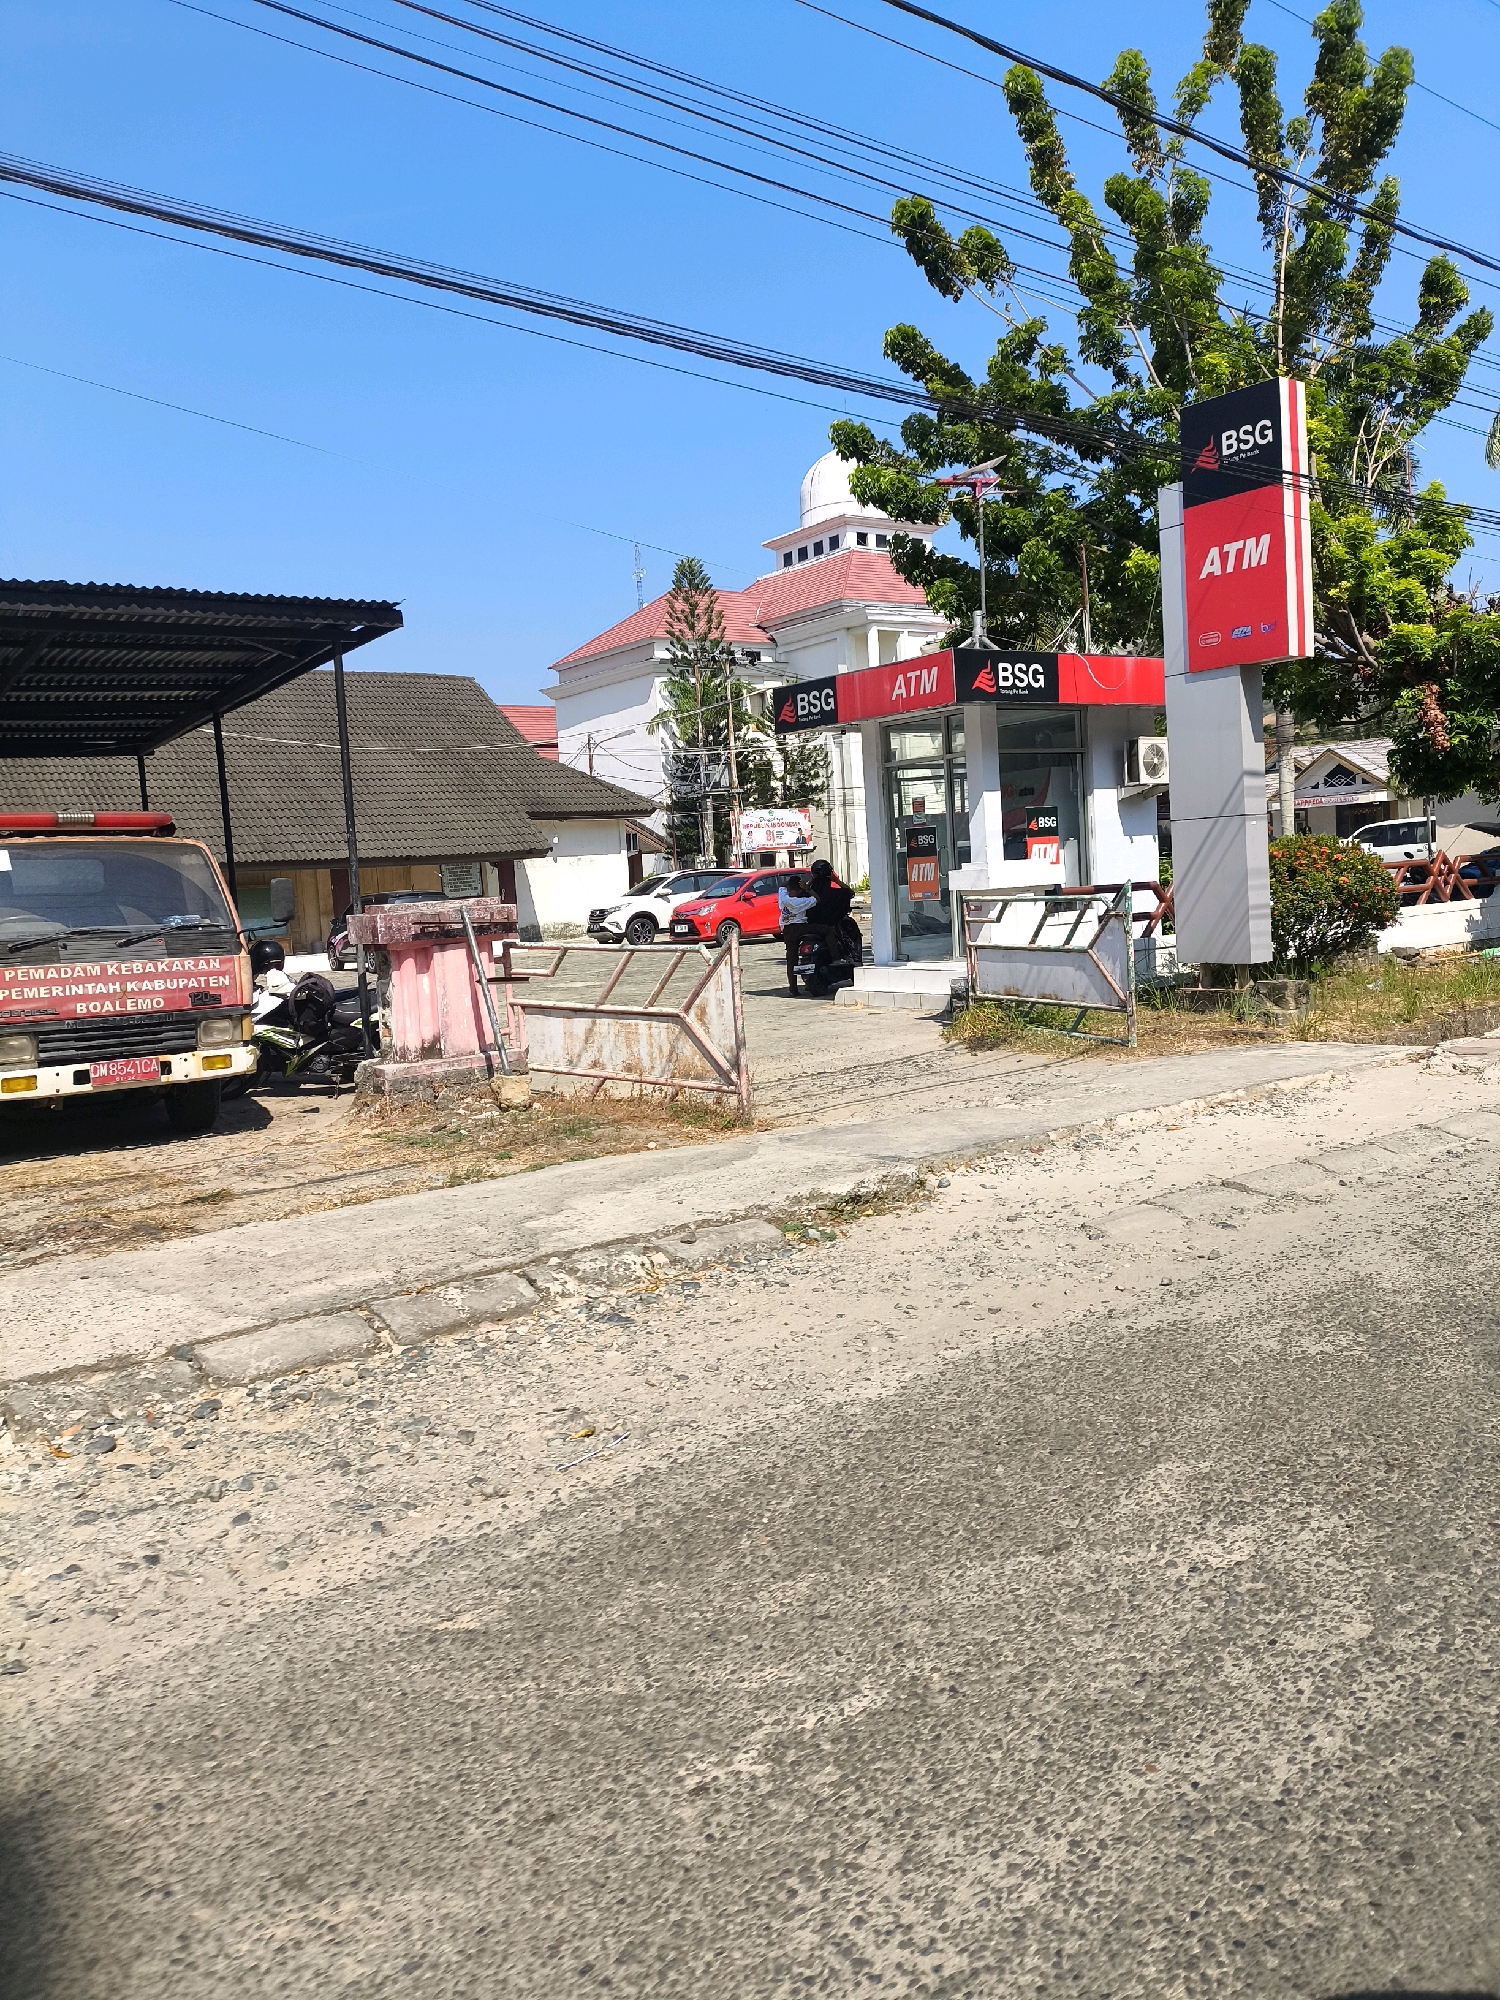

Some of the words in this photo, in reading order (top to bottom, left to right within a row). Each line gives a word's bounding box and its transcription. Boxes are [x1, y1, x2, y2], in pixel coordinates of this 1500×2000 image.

[1221, 419, 1273, 456] BSG
[1199, 533, 1271, 580] ATM
[891, 666, 939, 701] ATM
[997, 662, 1045, 688] BSG
[797, 688, 835, 716] BSG
[1038, 817, 1057, 828] BSG
[917, 834, 935, 845] BSG
[1030, 843, 1059, 863] ATM
[911, 863, 935, 882] ATM
[4, 965, 101, 982] PEMADAM
[106, 958, 221, 976] KEBAKARAN
[0, 981, 120, 1001] PEMERINTAH
[126, 975, 230, 993] KABUPATEN
[76, 997, 165, 1014] BOALEMO
[91, 1063, 108, 1078] DM
[109, 1060, 141, 1076] 8541
[141, 1058, 159, 1073] CA
